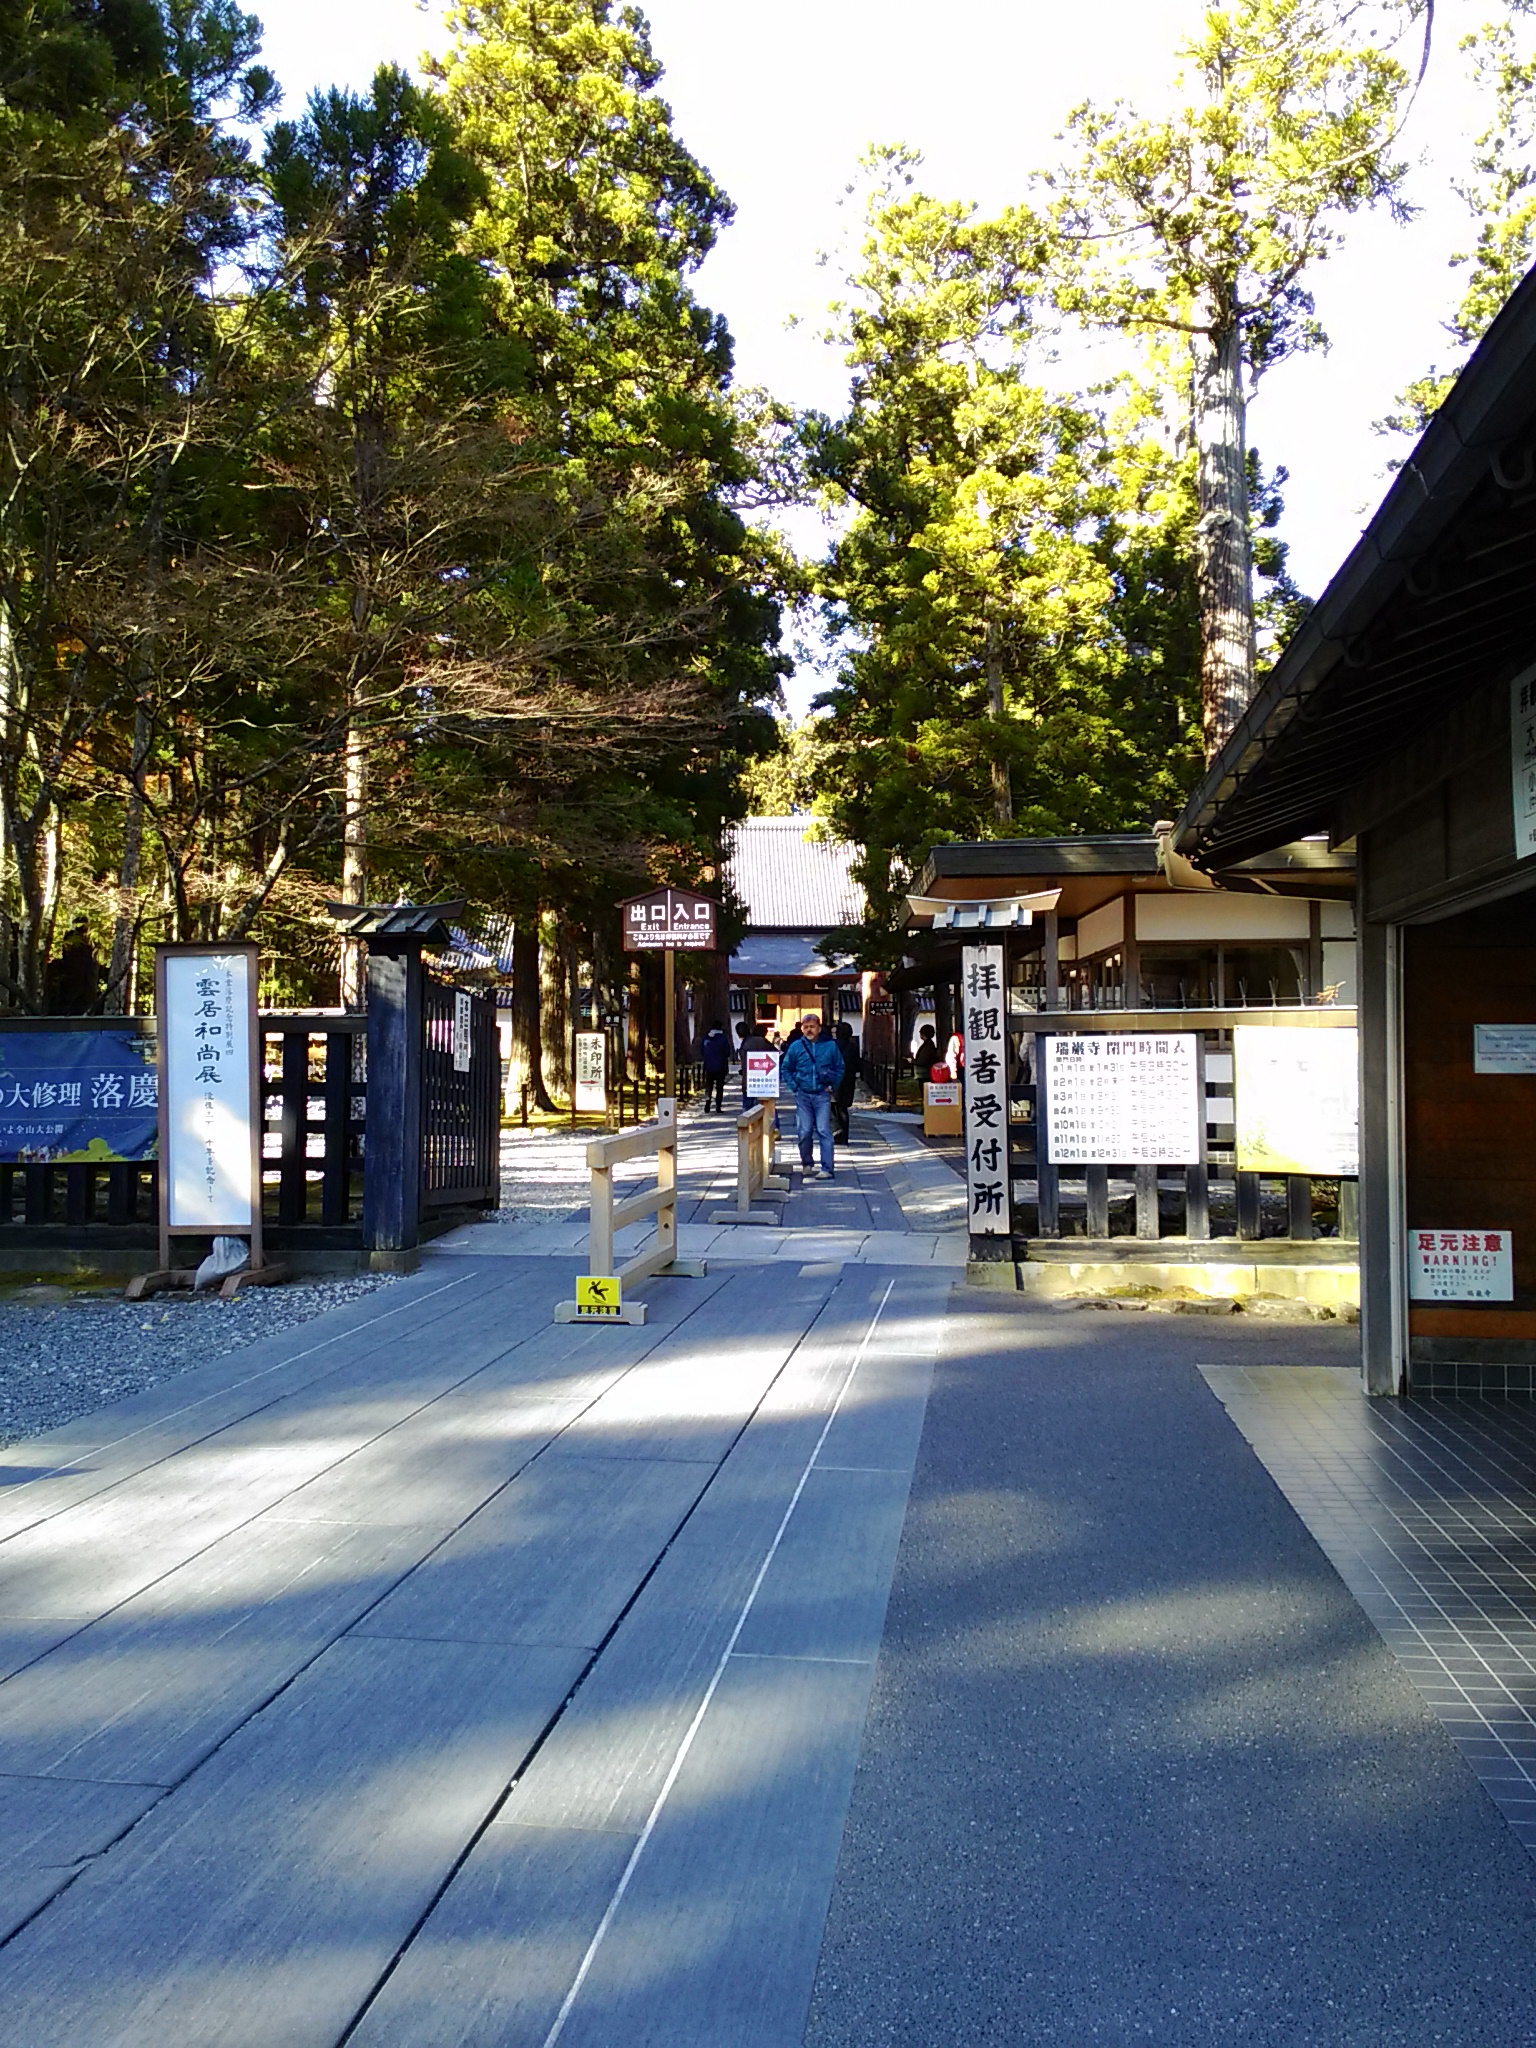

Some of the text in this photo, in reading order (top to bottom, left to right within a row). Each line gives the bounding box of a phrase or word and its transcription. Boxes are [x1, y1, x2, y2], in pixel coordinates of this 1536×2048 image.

[631, 905, 665, 921] 出口
[673, 904, 710, 920] 入口
[641, 923, 660, 931] Exit
[673, 922, 710, 930] Entrance
[194, 978, 222, 1083] 雲居和尚展
[590, 1036, 602, 1079] 朱印所
[0, 1073, 158, 1108] 大修理 落慶
[967, 962, 1004, 1217] 拝観者受付所
[1418, 1234, 1503, 1252] 足元注意
[1423, 1255, 1497, 1266] WARNING!
